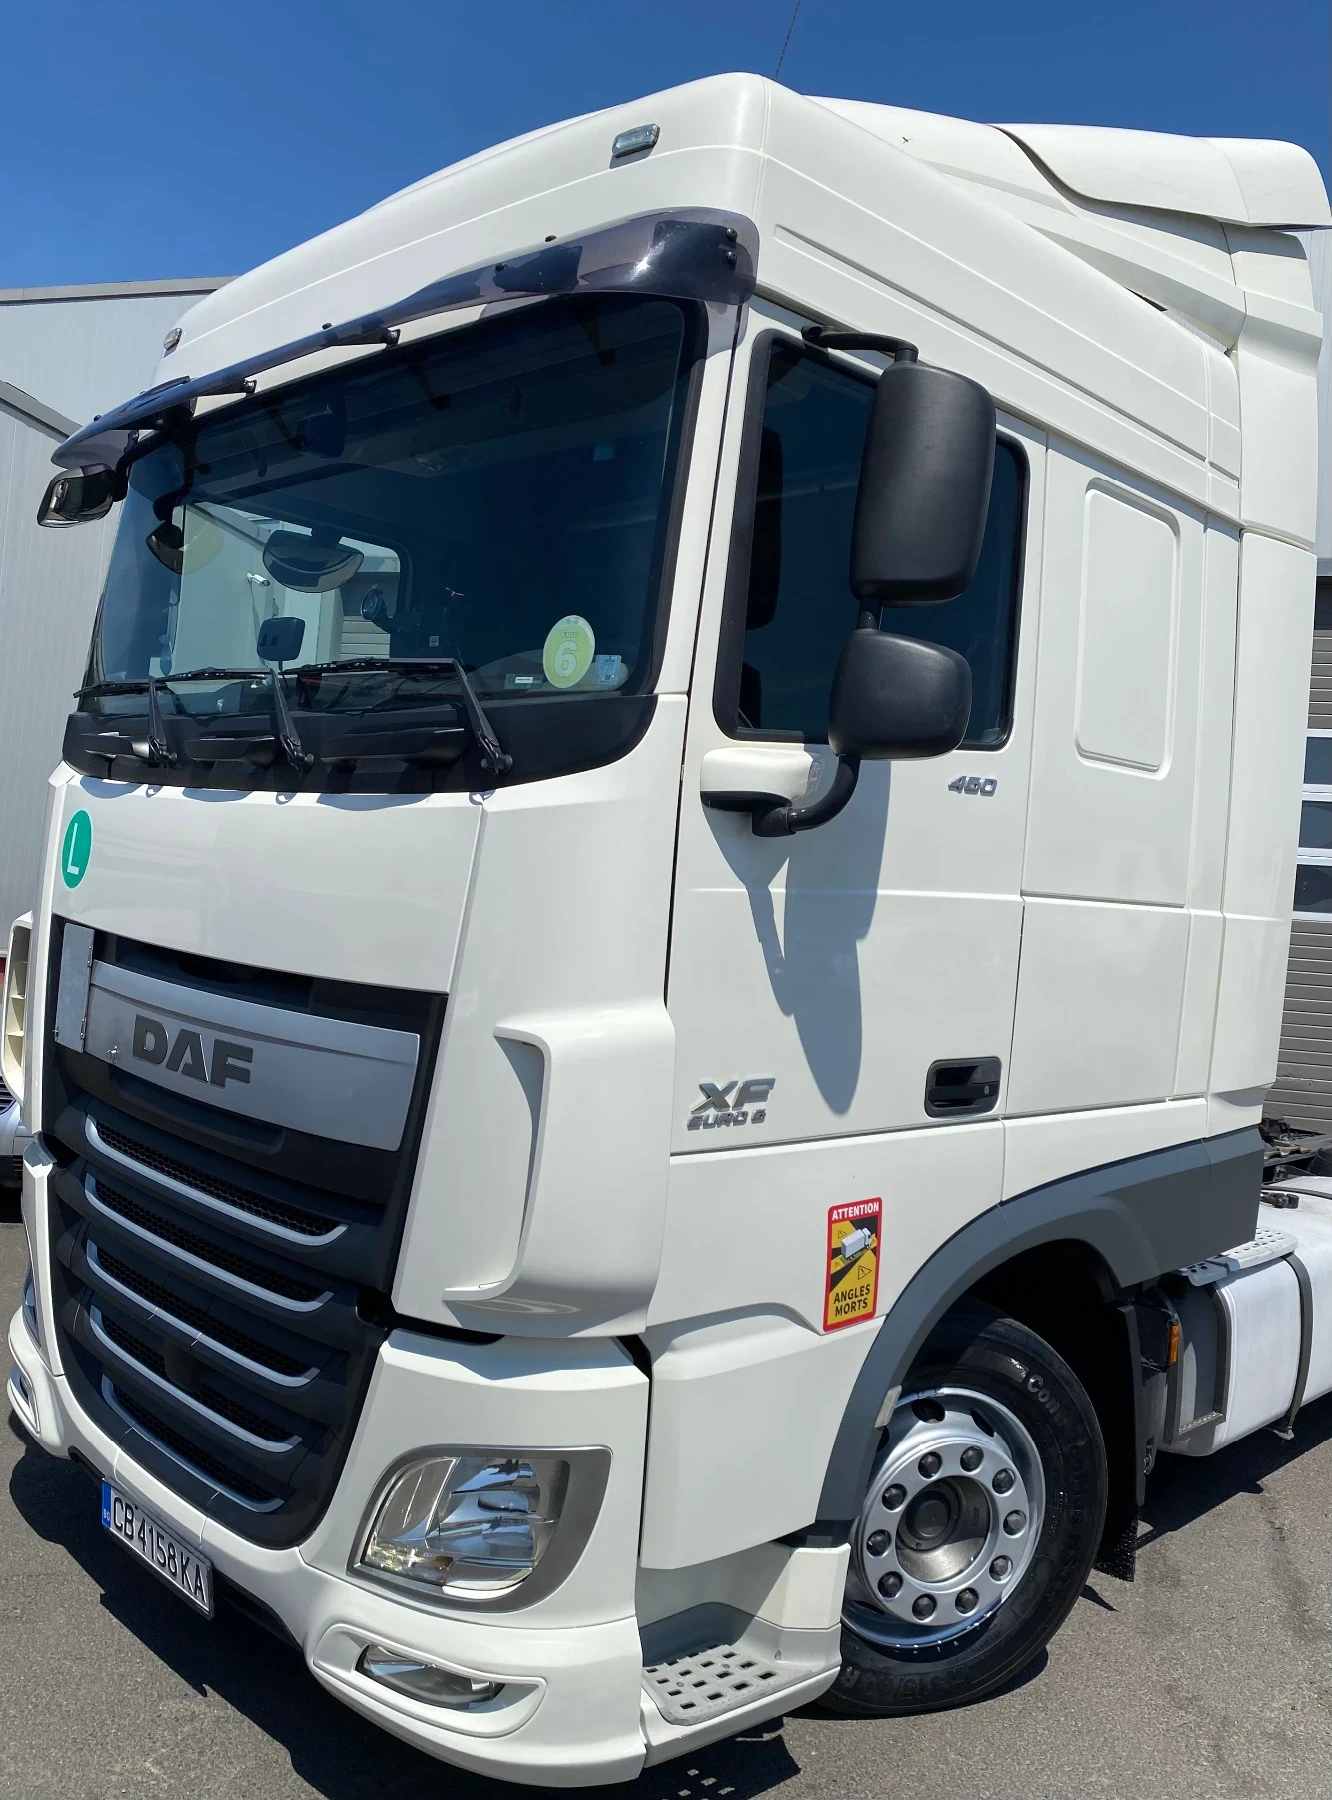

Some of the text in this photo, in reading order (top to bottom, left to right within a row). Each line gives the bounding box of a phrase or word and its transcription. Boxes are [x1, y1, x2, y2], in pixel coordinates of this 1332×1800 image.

[560, 629, 580, 639] Euro
[553, 640, 579, 679] 6
[947, 775, 998, 797] 460
[67, 822, 80, 875] L
[132, 1013, 254, 1089] DAF
[690, 1077, 776, 1114] XF
[686, 1109, 766, 1131] EURO 6
[831, 1201, 879, 1221] ATTENTION
[833, 1283, 871, 1305] ANGLES
[834, 1297, 869, 1317] MORTS
